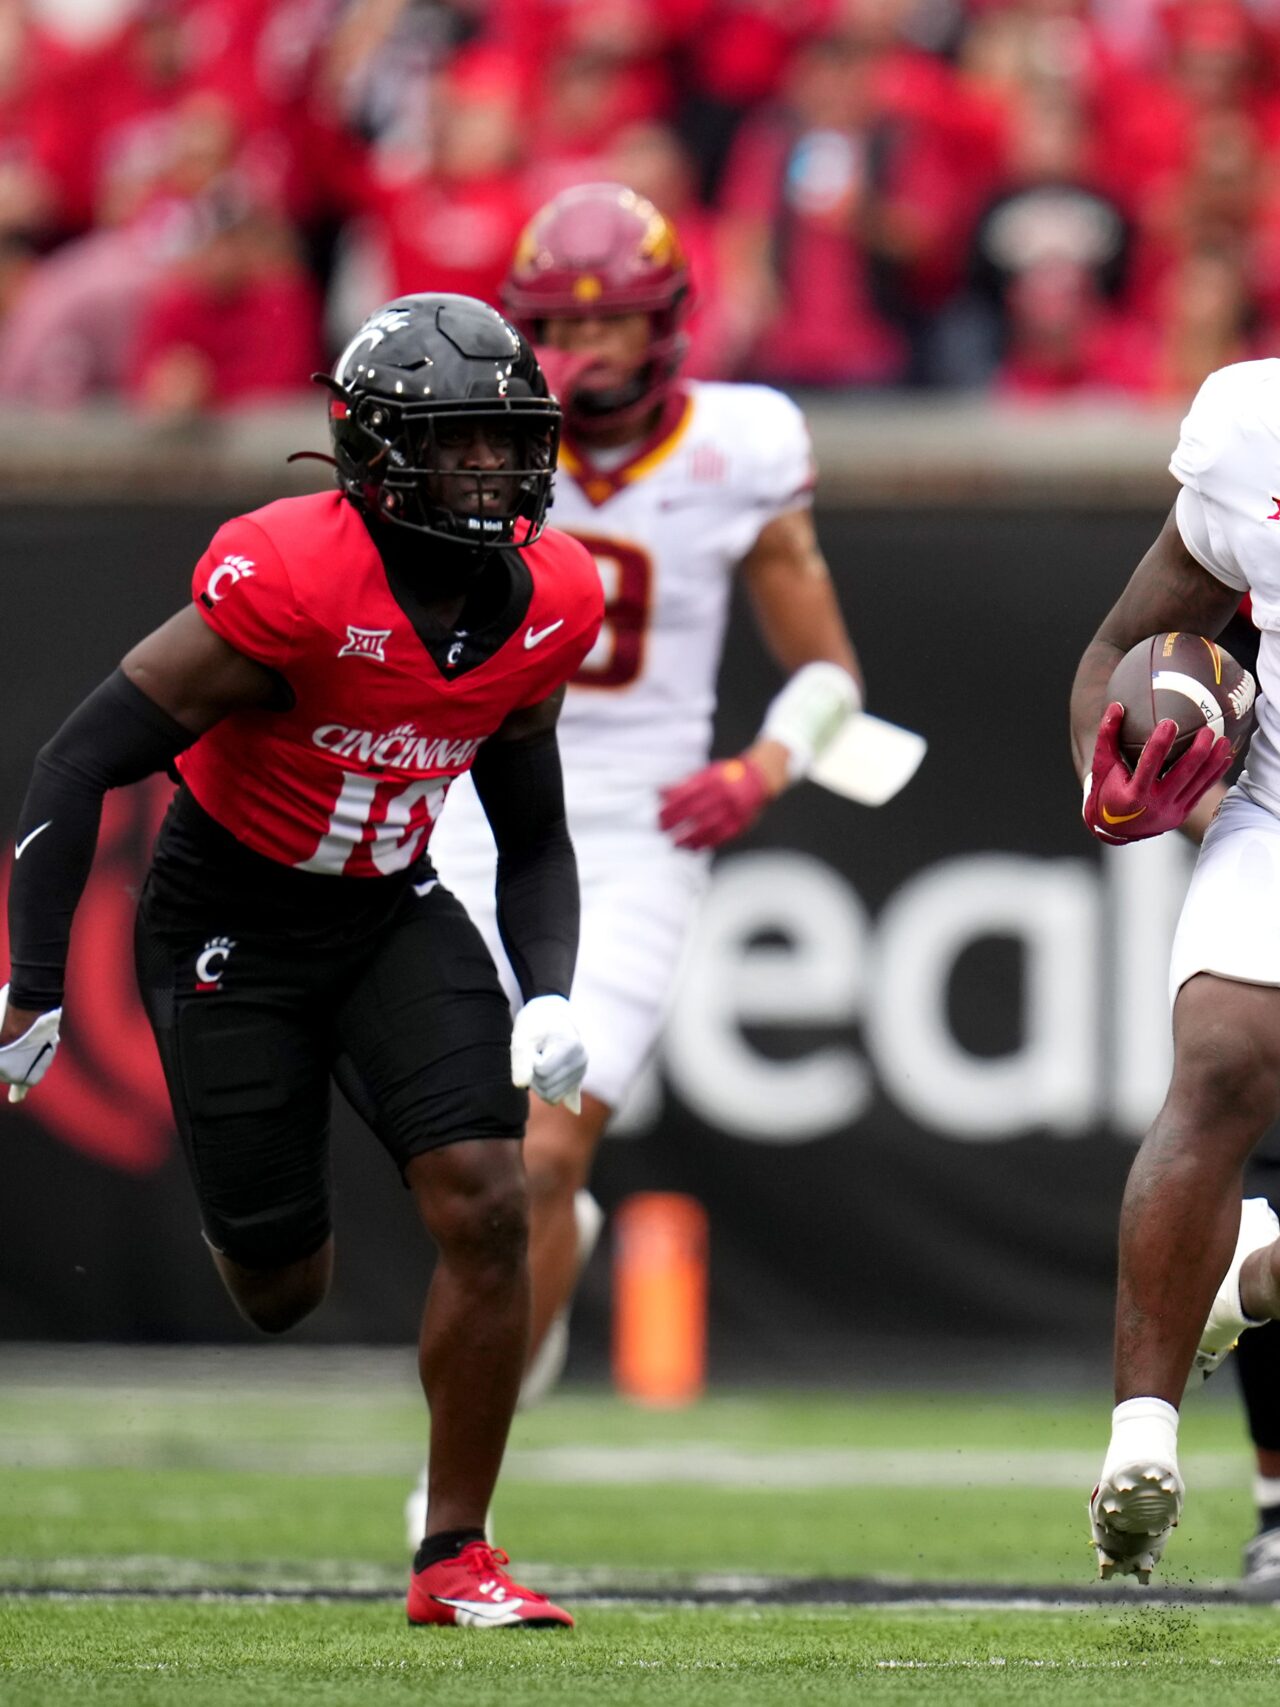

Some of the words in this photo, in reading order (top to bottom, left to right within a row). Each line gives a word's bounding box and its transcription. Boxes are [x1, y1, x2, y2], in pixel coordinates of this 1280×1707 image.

[312, 723, 488, 769] CINCINNAT
[293, 771, 451, 876] 10
[612, 838, 1180, 1142] eal
